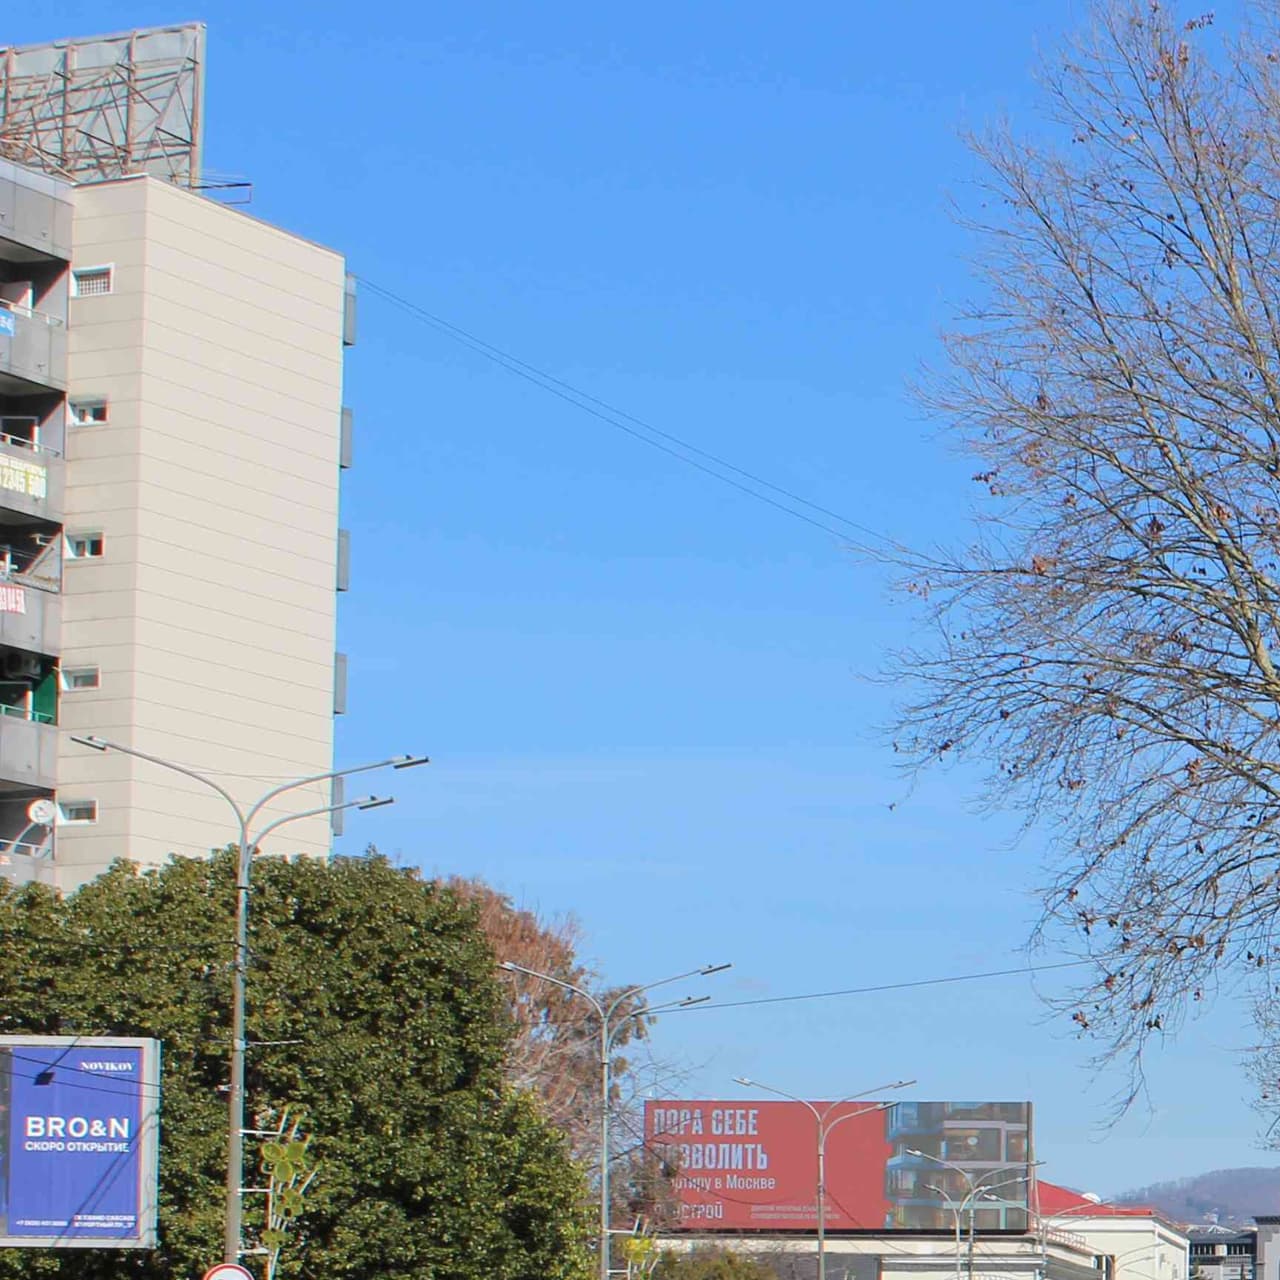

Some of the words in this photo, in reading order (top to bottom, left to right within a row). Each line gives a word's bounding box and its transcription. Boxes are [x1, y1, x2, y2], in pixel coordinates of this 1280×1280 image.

[80, 1061, 135, 1072] NOVIKOV
[25, 1116, 131, 1139] BRO&N
[653, 1108, 704, 1135] ПОРА
[711, 1108, 760, 1136] СЕБЕ
[24, 1141, 65, 1151] СКОРО
[66, 1141, 130, 1153] ОТКРЫТИЕ
[714, 1178, 723, 1189] в
[725, 1174, 777, 1190] Москве
